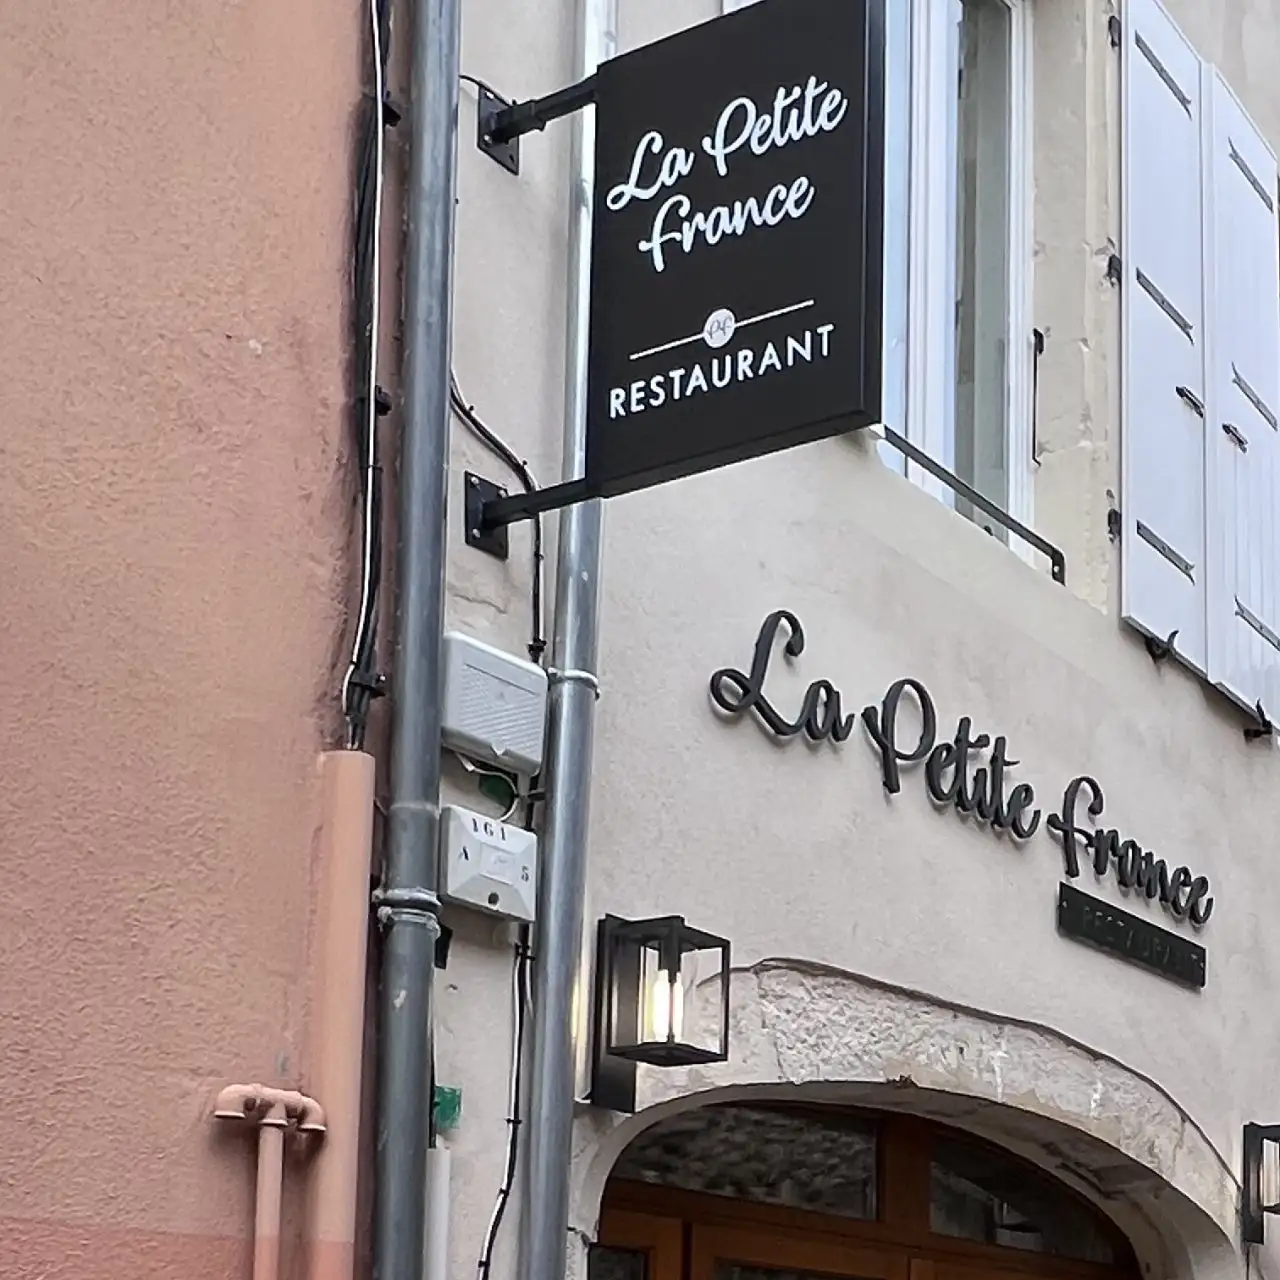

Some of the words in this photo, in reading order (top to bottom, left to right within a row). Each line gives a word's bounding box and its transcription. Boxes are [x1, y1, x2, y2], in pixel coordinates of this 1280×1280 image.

[606, 130, 695, 211] La
[702, 75, 848, 177] Petite
[608, 323, 835, 419] RESTAURANT
[709, 610, 854, 742] La
[862, 678, 1041, 839] Petite
